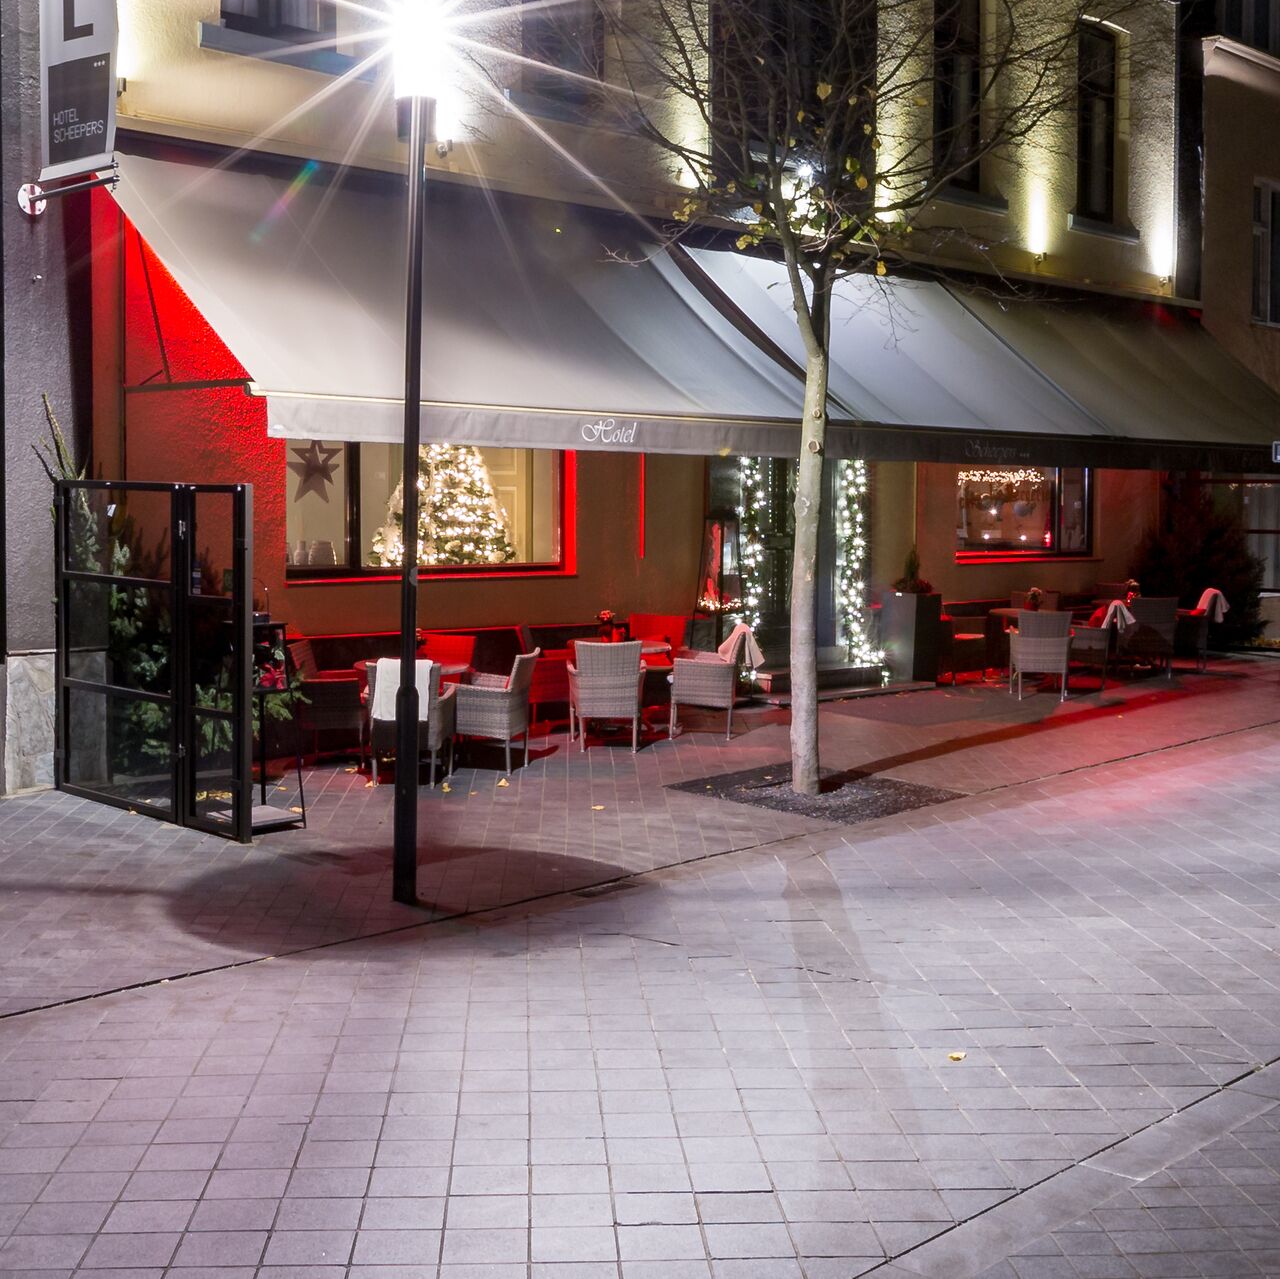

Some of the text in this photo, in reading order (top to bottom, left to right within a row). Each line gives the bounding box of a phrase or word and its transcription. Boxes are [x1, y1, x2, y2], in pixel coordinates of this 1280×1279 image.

[52, 108, 80, 127] HOTEL
[53, 119, 104, 144] SCHEEPERS
[581, 418, 637, 443] Hotel
